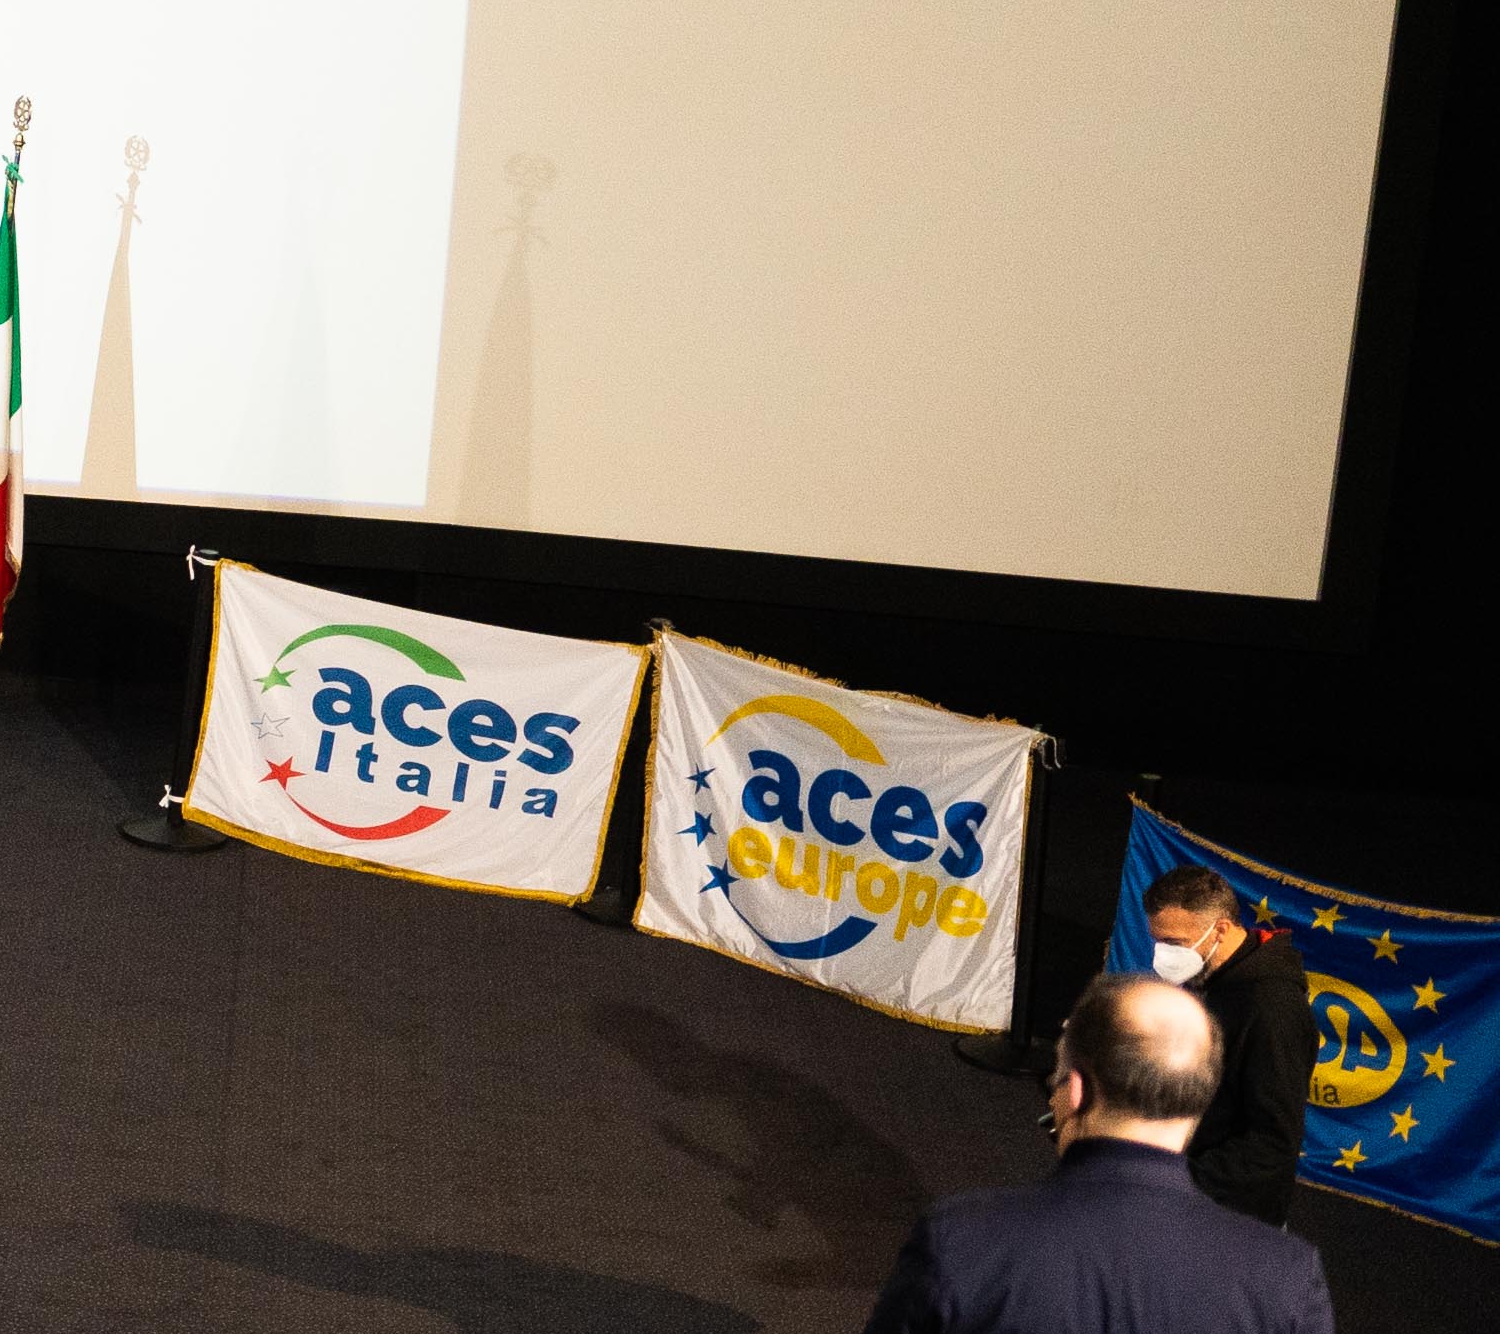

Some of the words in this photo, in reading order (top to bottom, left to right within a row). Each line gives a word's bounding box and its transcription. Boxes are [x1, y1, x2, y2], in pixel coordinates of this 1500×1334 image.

[311, 666, 581, 775] aces
[741, 749, 988, 879] aces
[727, 826, 988, 942] europe
